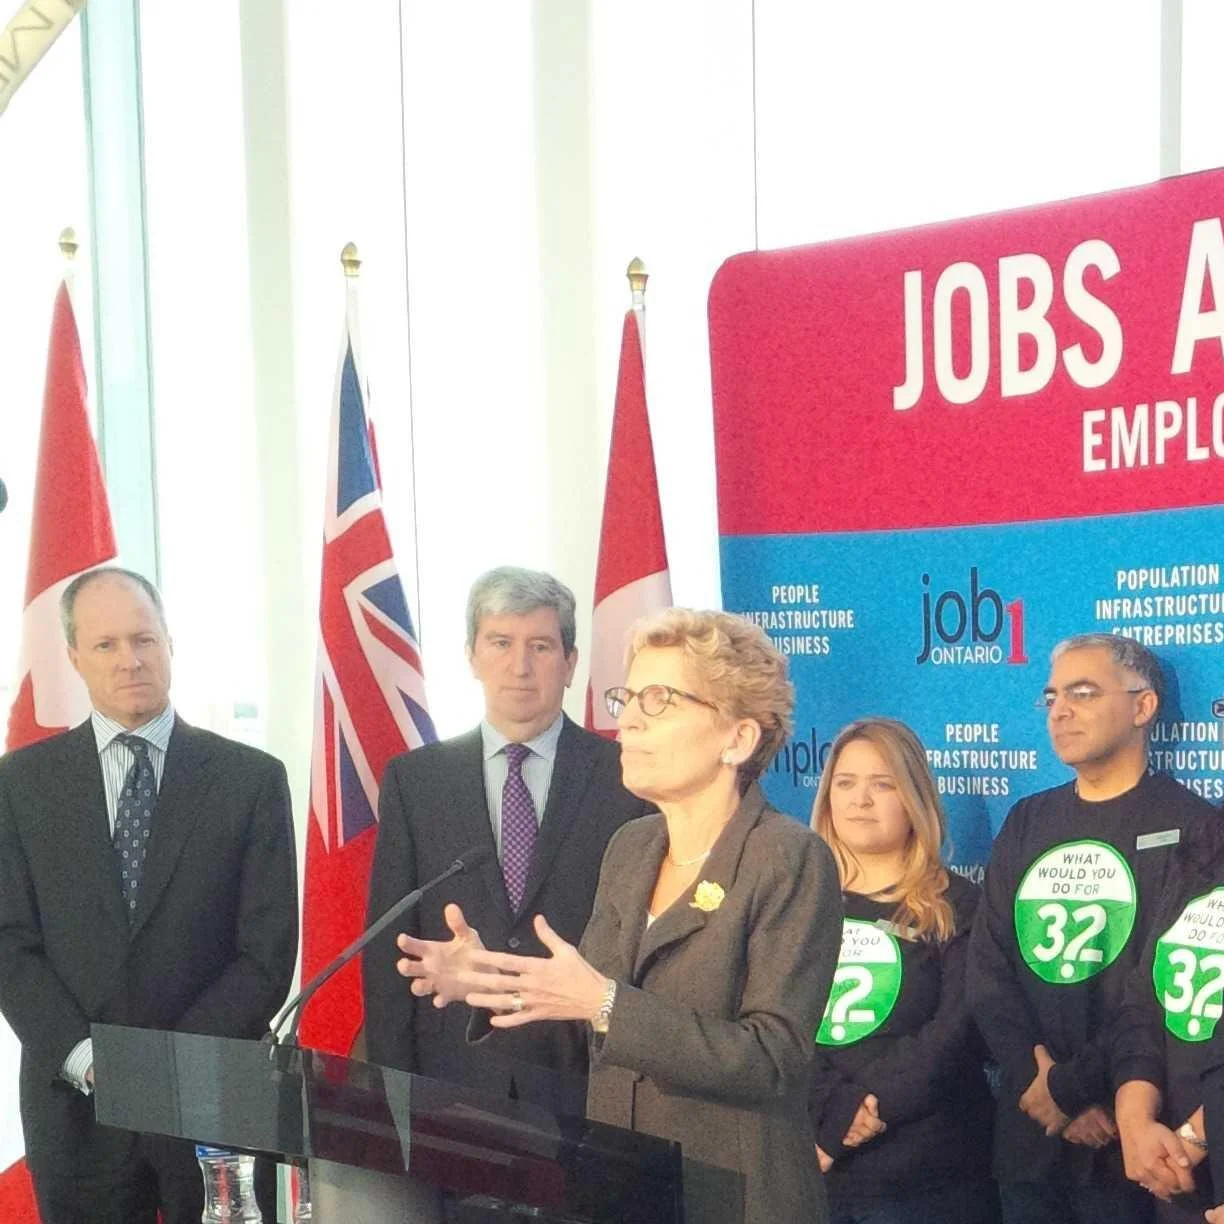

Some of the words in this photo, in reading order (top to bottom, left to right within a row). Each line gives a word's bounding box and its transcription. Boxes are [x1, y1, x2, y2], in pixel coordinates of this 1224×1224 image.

[893, 239, 1124, 411] JOBS
[1116, 564, 1220, 591] POPULATION
[772, 584, 820, 604] PEOPLE
[769, 635, 830, 655] USINESS
[931, 645, 1003, 665] ONTARIO
[945, 723, 999, 743] PEOPLE
[1150, 721, 1219, 742] ULATION
[926, 750, 1037, 770] FRASTRUCTURE
[937, 776, 1009, 796] BUSINESS
[1063, 853, 1101, 865] WHAT
[1038, 867, 1087, 879] WOULD
[1092, 867, 1117, 879] YOU
[1051, 883, 1071, 895] DO
[1074, 883, 1101, 896] FOR
[851, 936, 881, 946] YOU
